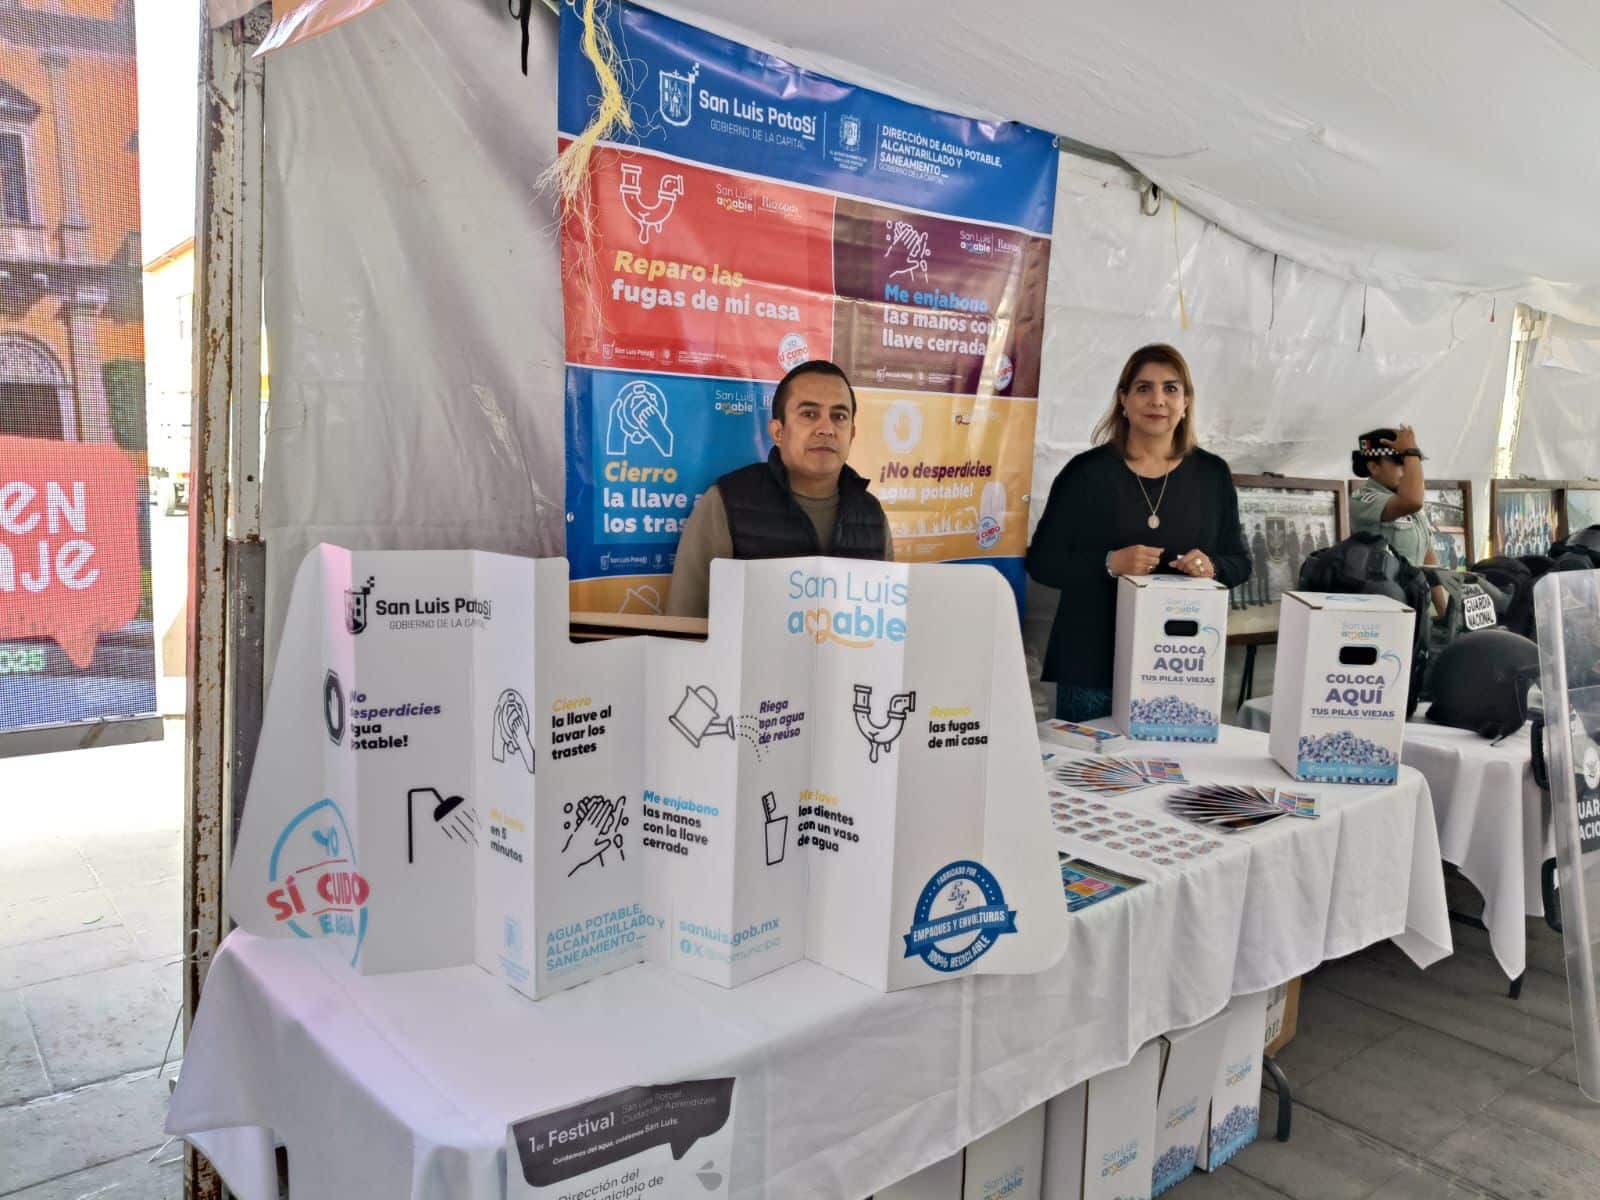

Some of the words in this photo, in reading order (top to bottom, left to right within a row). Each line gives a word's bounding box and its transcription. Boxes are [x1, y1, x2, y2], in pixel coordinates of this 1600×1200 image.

[699, 90, 728, 114] San
[734, 98, 764, 122] Luis
[710, 119, 750, 138] GOBIERNO
[752, 128, 762, 141] DE
[764, 132, 774, 143] LA
[776, 134, 806, 150] CAPITAL
[881, 139, 955, 166] ALCANTARILLADO
[956, 160, 962, 168] Y
[882, 126, 928, 148] DIRECCIÓN
[930, 138, 939, 149] DE
[941, 140, 963, 157] AGUA
[965, 147, 1003, 168] POTABLE,
[716, 184, 734, 196] San
[960, 230, 974, 240] San
[614, 250, 706, 282] Reparo
[712, 264, 744, 288] las
[612, 278, 686, 310] fugas
[691, 289, 720, 312] de
[725, 292, 749, 315] mi
[755, 301, 800, 321] casa
[884, 283, 909, 302] Me
[913, 288, 989, 312] enjabono
[884, 306, 909, 326] las
[913, 312, 967, 332] manos
[882, 328, 924, 349] llave
[928, 337, 987, 356] cerrada
[715, 390, 733, 401] San
[735, 392, 753, 402] Luis
[604, 460, 678, 483] Cierro
[880, 461, 909, 483] ¡No
[913, 460, 992, 482] desperdicies
[604, 488, 624, 508] la
[632, 488, 687, 508] llave
[921, 483, 973, 504] potable!
[604, 513, 637, 533] los
[789, 570, 836, 599] San
[847, 571, 909, 606] Luis
[376, 600, 410, 615] San
[415, 597, 450, 614] Luis
[1466, 596, 1490, 612] GUARDIA
[390, 618, 434, 630] GOBIERNO
[437, 618, 448, 629] DE
[451, 618, 463, 628] LA
[1468, 611, 1494, 627] NACIONAL
[1154, 644, 1206, 654] COLOCA
[1154, 654, 1205, 673] AQUÍ
[1326, 674, 1385, 684] COLOCA
[552, 697, 592, 713] Cierro
[1326, 686, 1384, 706] AQUÍ
[552, 716, 564, 728] la
[567, 711, 597, 726] llave
[600, 704, 612, 718] al
[759, 700, 789, 714] Riega
[779, 711, 805, 727] agua
[929, 721, 946, 733] las
[948, 720, 980, 734] fugas
[552, 729, 585, 744] lavar
[588, 724, 605, 737] los
[759, 731, 771, 744] de
[928, 737, 943, 749] de
[945, 735, 959, 747] mi
[961, 735, 988, 746] casa
[552, 742, 597, 760] trastes
[643, 790, 660, 803] Me
[663, 795, 720, 816] enjabono
[643, 804, 660, 818] las
[662, 811, 701, 828] manos
[798, 805, 812, 817] los
[814, 805, 854, 826] dientes
[643, 822, 663, 834] con
[666, 824, 677, 838] la
[680, 828, 708, 845] llave
[798, 821, 816, 832] con
[818, 822, 831, 834] un
[833, 827, 860, 843] vaso
[490, 840, 523, 863] minutos
[643, 836, 688, 855] cerrada
[798, 834, 810, 846] de
[812, 836, 839, 852] agua
[317, 872, 369, 906] CUIDO
[546, 922, 582, 944] AGUA
[585, 903, 642, 930] POTABLE,
[914, 921, 951, 942] EMPAQUES
[953, 920, 958, 930] Y
[546, 914, 655, 957] ALCANTARILLADO
[658, 919, 665, 929] Y
[546, 932, 635, 972] SANEAMIENTO
[950, 935, 991, 968] RECICLABLE
[548, 1112, 614, 1147] Festival
[587, 1146, 597, 1154] del
[645, 1122, 659, 1133] San
[660, 1117, 679, 1128] Luis
[621, 1168, 639, 1184] del
[648, 1176, 664, 1188] de
